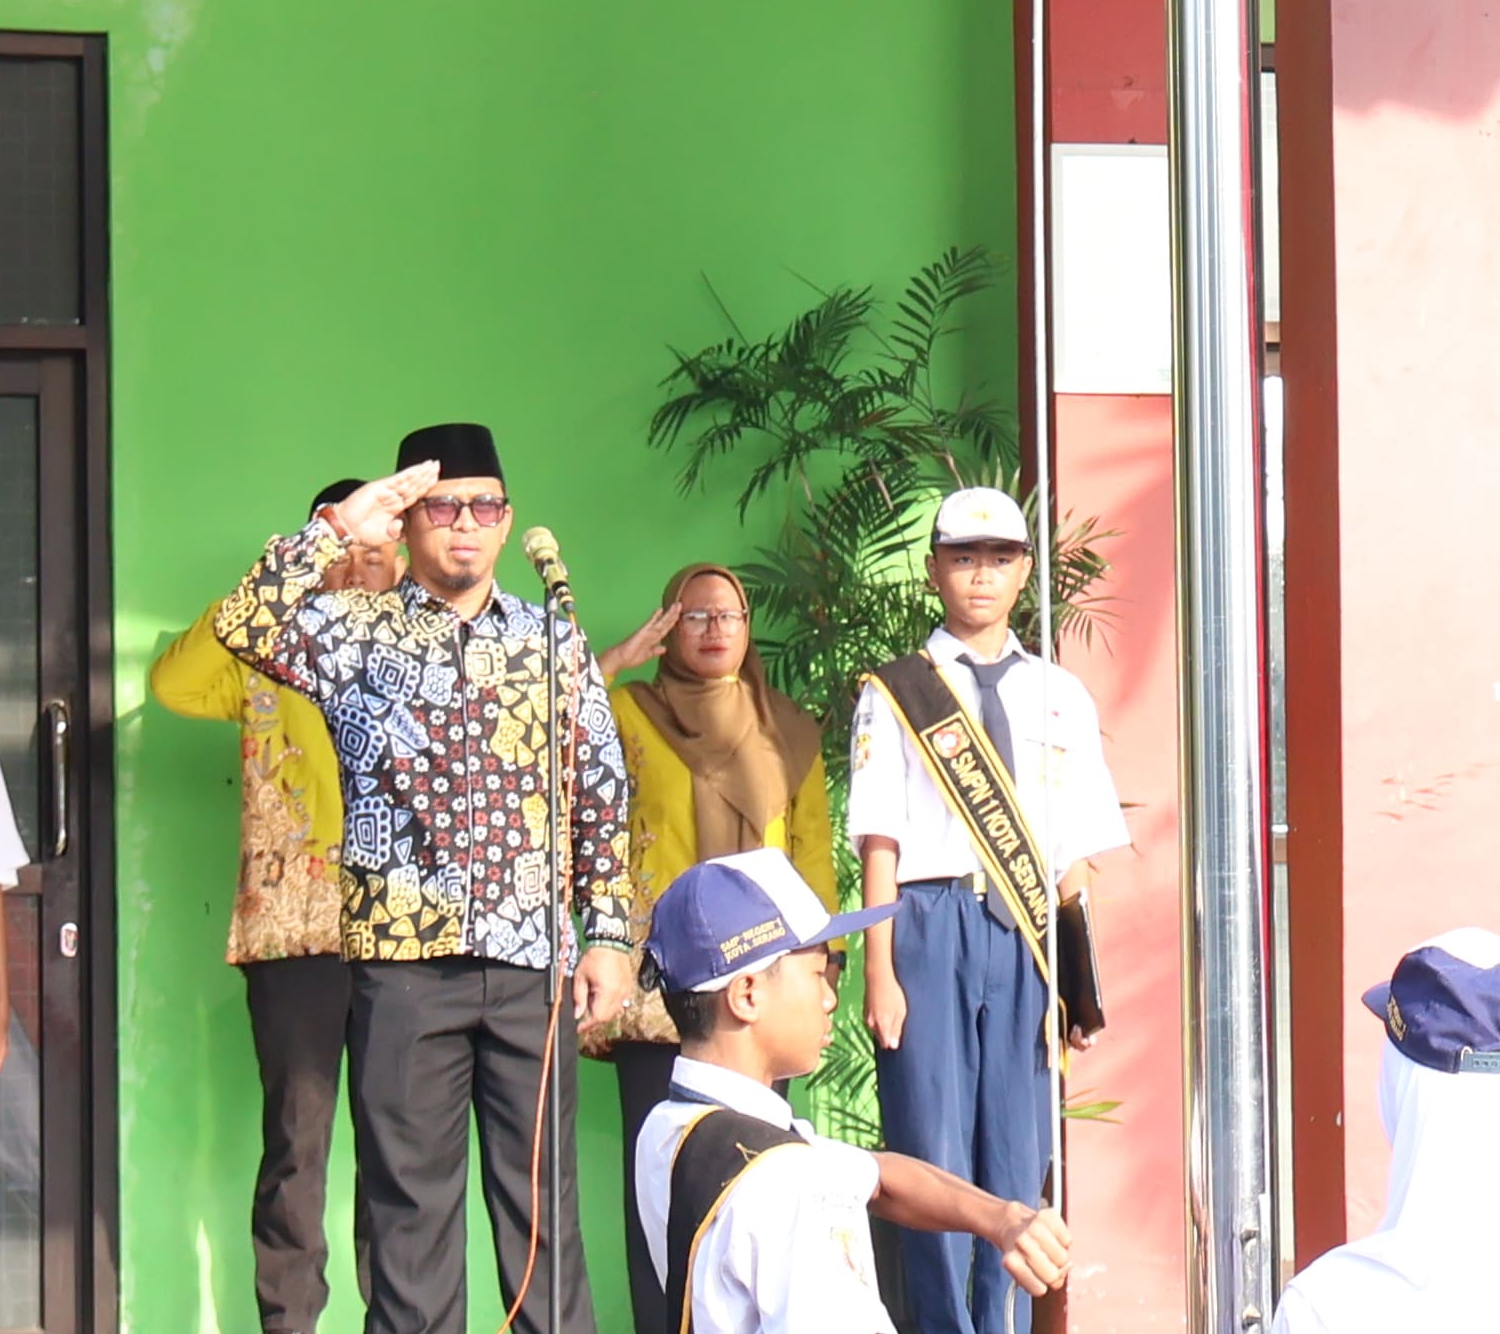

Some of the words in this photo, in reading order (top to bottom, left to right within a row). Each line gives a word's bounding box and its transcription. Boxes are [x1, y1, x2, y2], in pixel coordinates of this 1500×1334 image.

[951, 750, 994, 805] SMPN
[978, 798, 999, 815] 1
[983, 808, 1021, 858] KOTA
